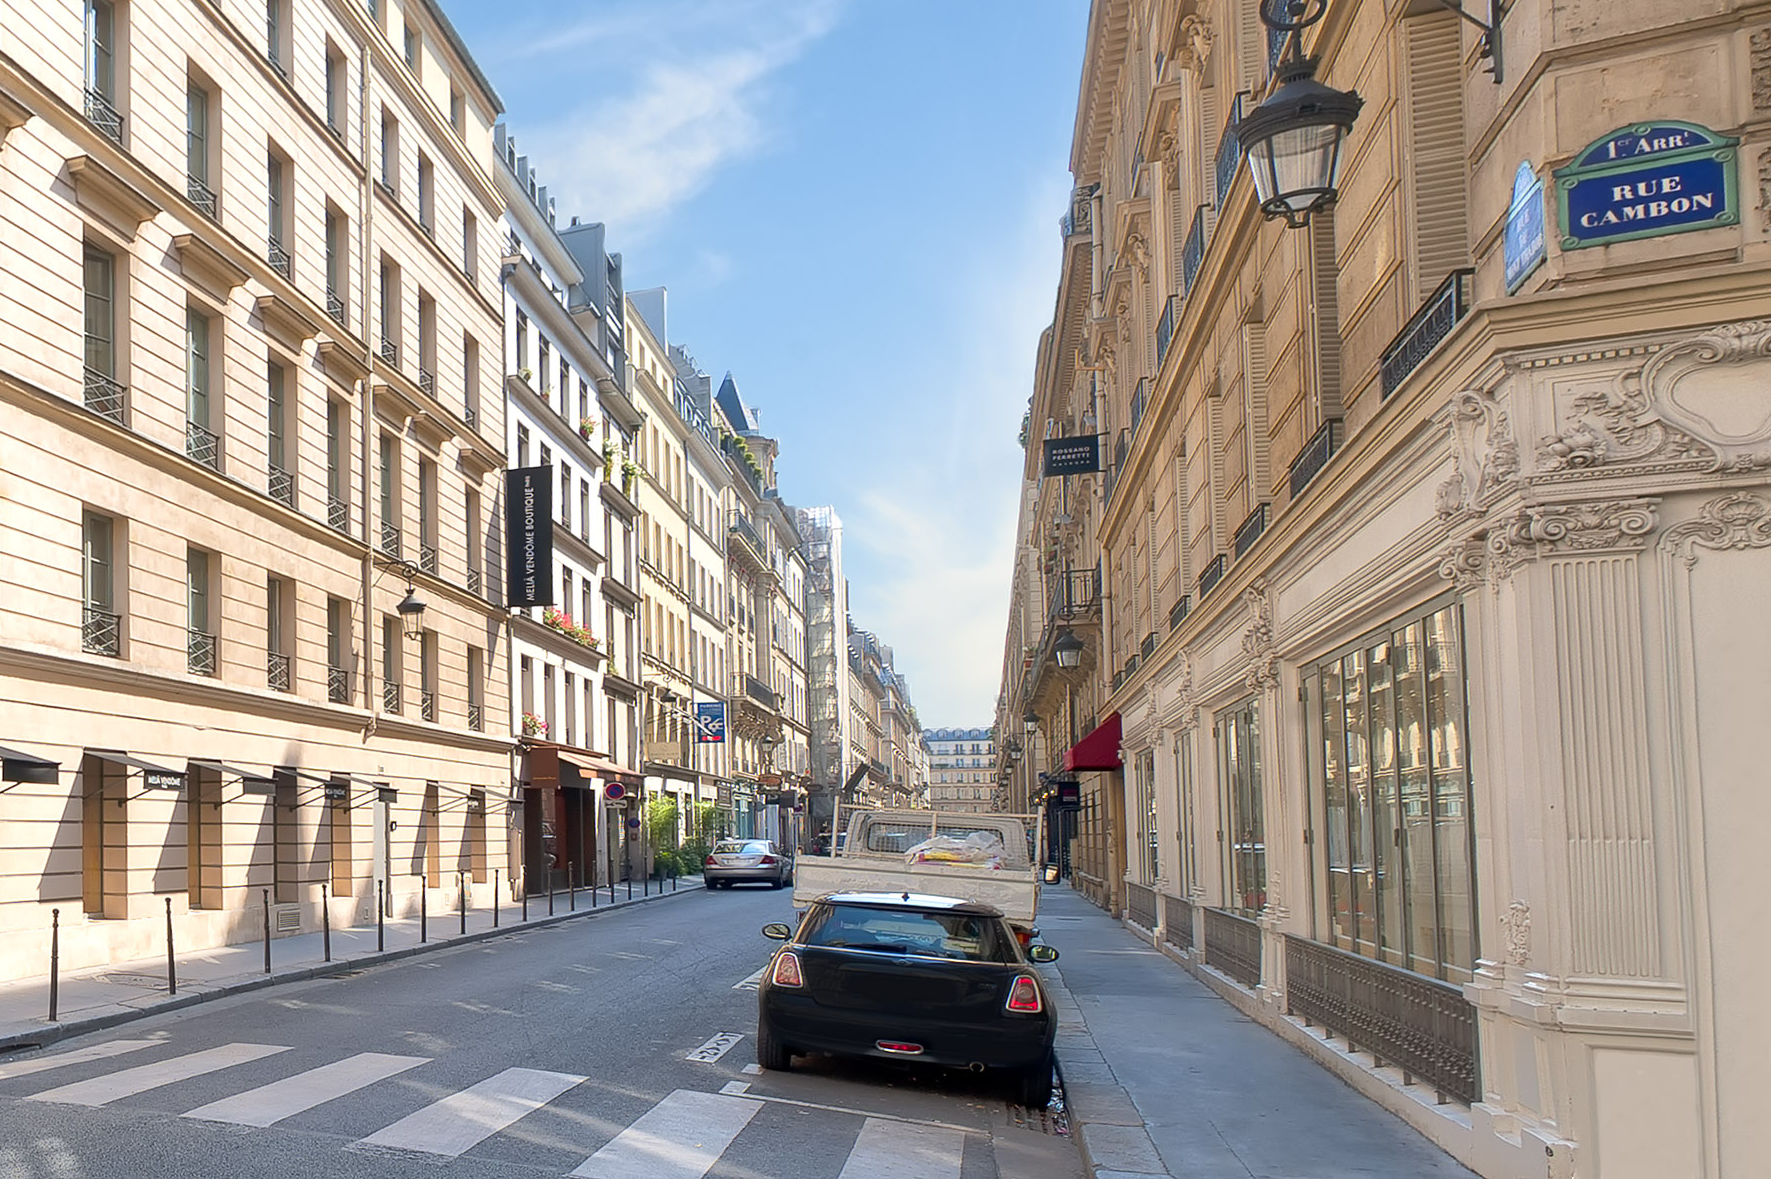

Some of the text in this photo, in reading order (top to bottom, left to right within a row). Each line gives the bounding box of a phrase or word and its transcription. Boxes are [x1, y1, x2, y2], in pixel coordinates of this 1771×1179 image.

[1612, 176, 1682, 202] RUE
[1580, 192, 1714, 228] CAMBON
[524, 487, 534, 530] BOUTIQUE
